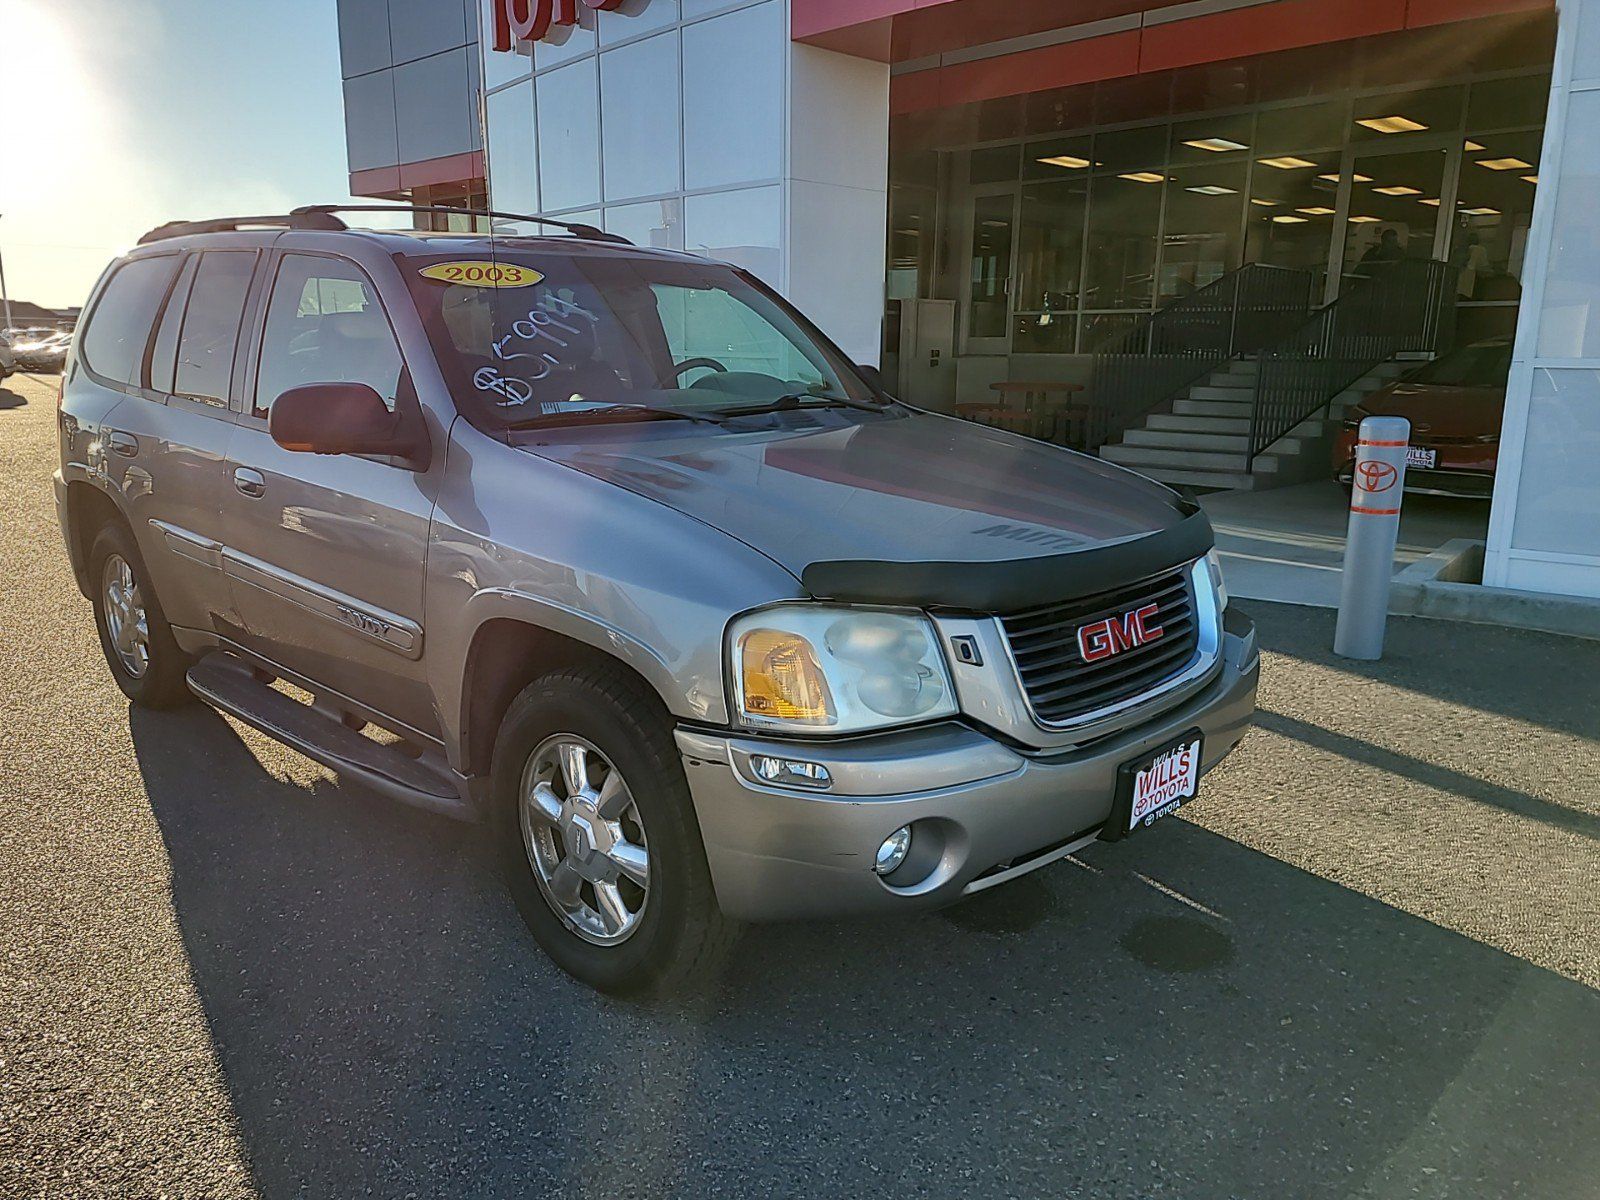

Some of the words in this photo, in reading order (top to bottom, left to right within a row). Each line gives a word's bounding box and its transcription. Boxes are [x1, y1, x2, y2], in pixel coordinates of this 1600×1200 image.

[445, 267, 521, 282] 2003
[1078, 603, 1163, 662] GMC
[1139, 751, 1190, 798] WILLS
[1149, 777, 1189, 808] TOYOTA
[1156, 799, 1181, 820] TOYOTA
